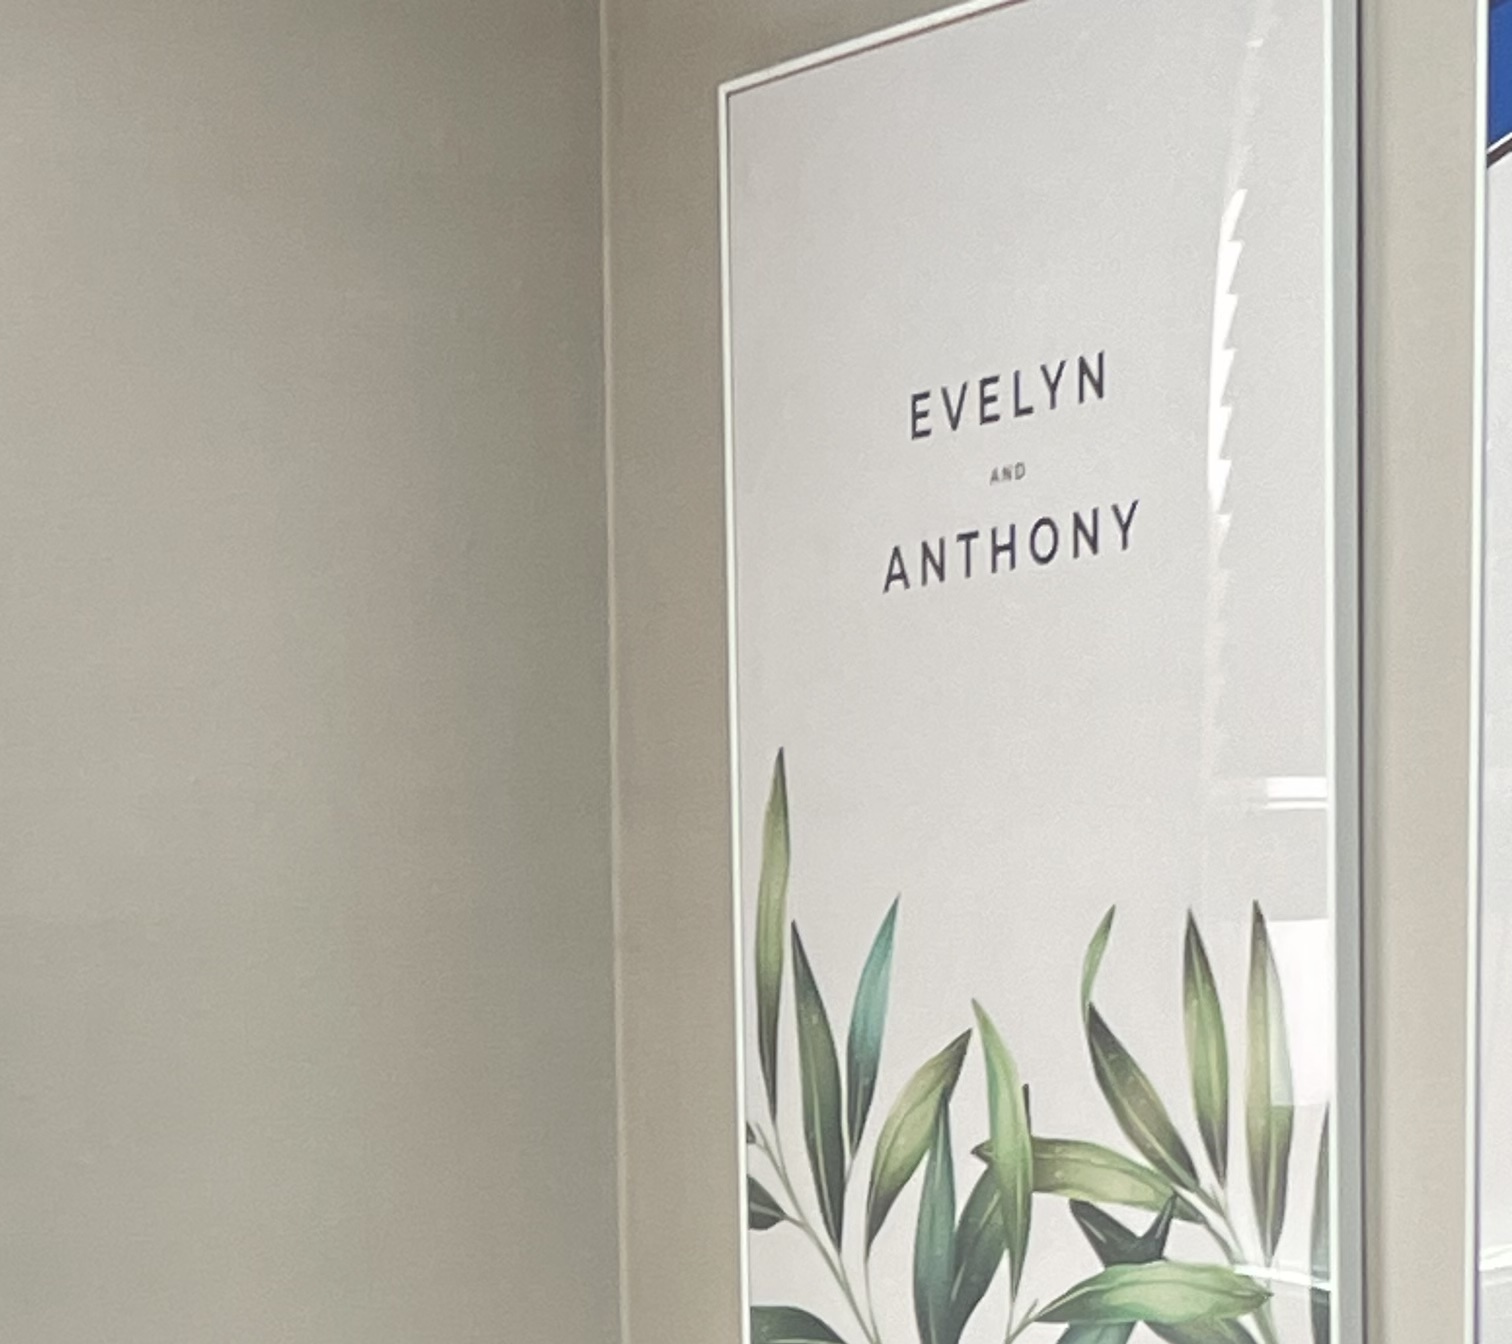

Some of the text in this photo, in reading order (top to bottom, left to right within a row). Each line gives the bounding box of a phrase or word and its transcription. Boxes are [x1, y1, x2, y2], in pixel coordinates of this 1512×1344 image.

[910, 350, 1105, 440] EVELYN
[989, 461, 1027, 486] AND
[882, 499, 1140, 594] ANTHONY
